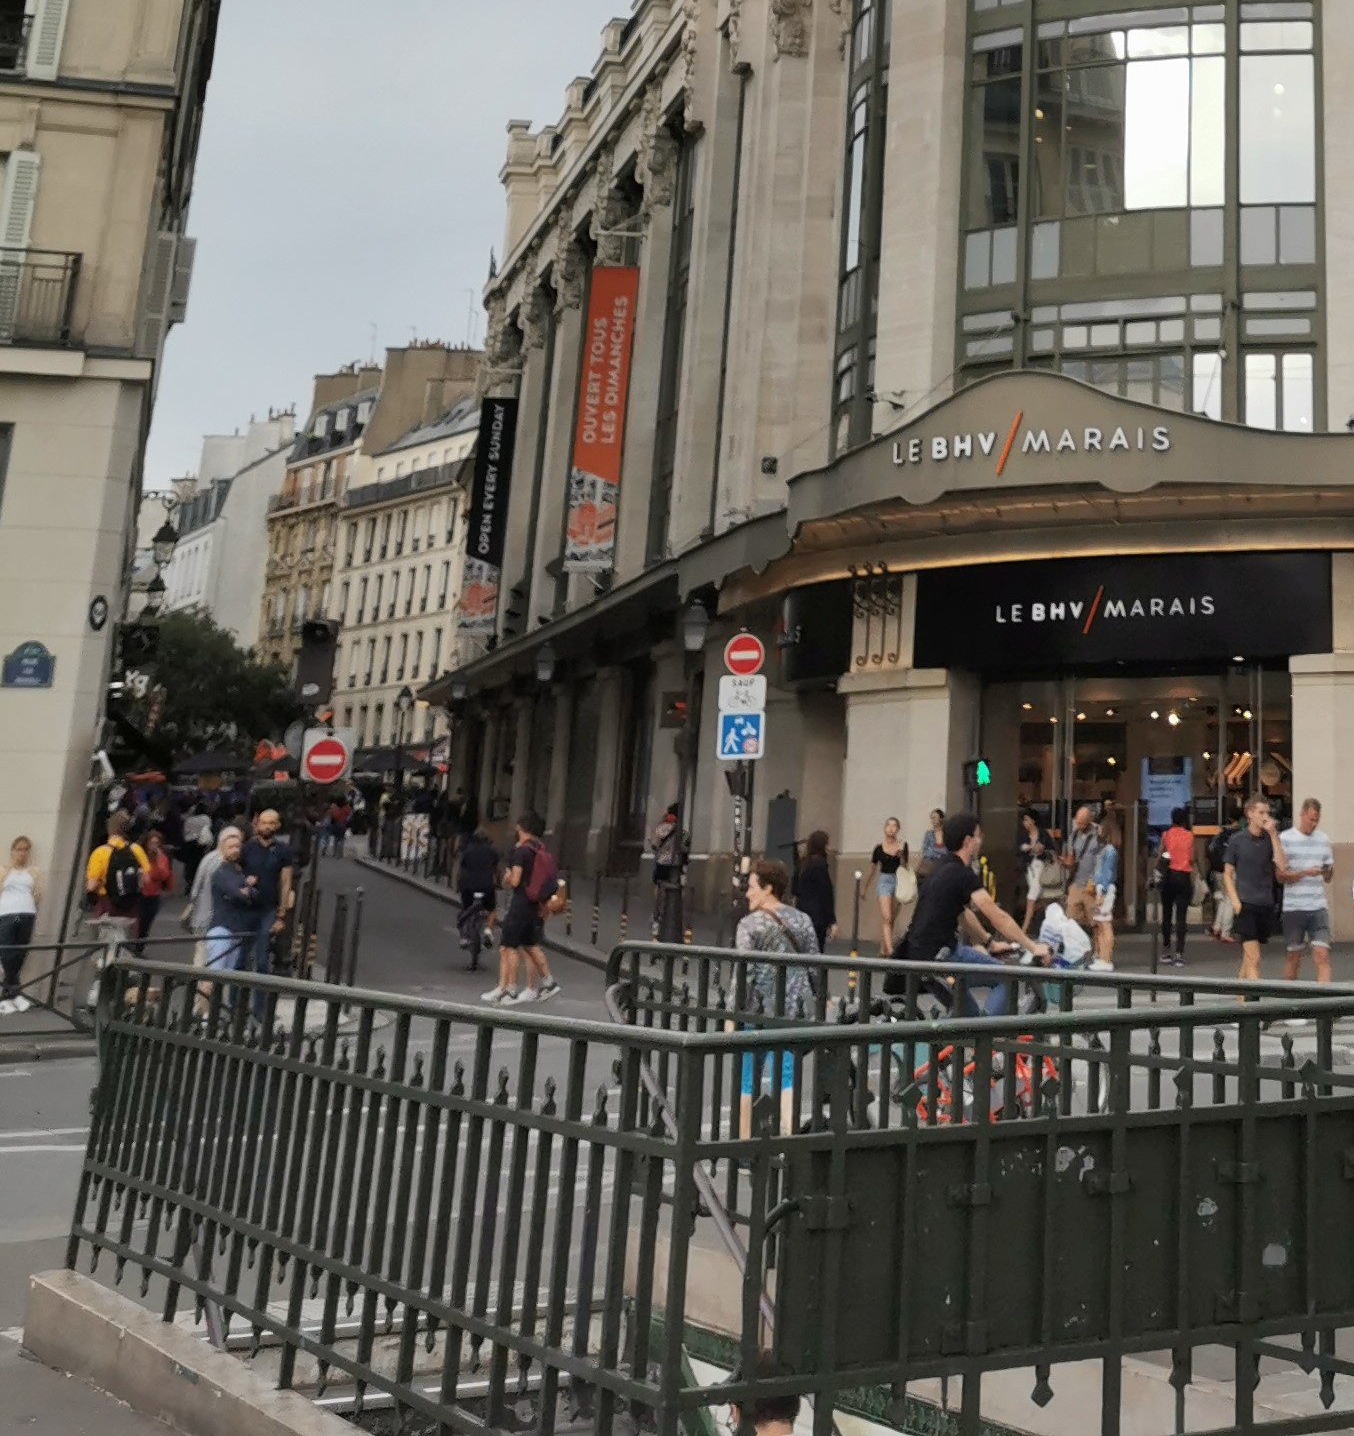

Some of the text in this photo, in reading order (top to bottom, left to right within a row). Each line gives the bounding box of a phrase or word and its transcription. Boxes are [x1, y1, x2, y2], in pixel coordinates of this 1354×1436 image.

[583, 316, 609, 444] OUVERT TOUS
[601, 295, 629, 445] LES DIMANCHES
[477, 403, 506, 555] OPEN EVERY SUNDAY
[892, 438, 922, 464] LE
[995, 604, 1023, 623] LE
